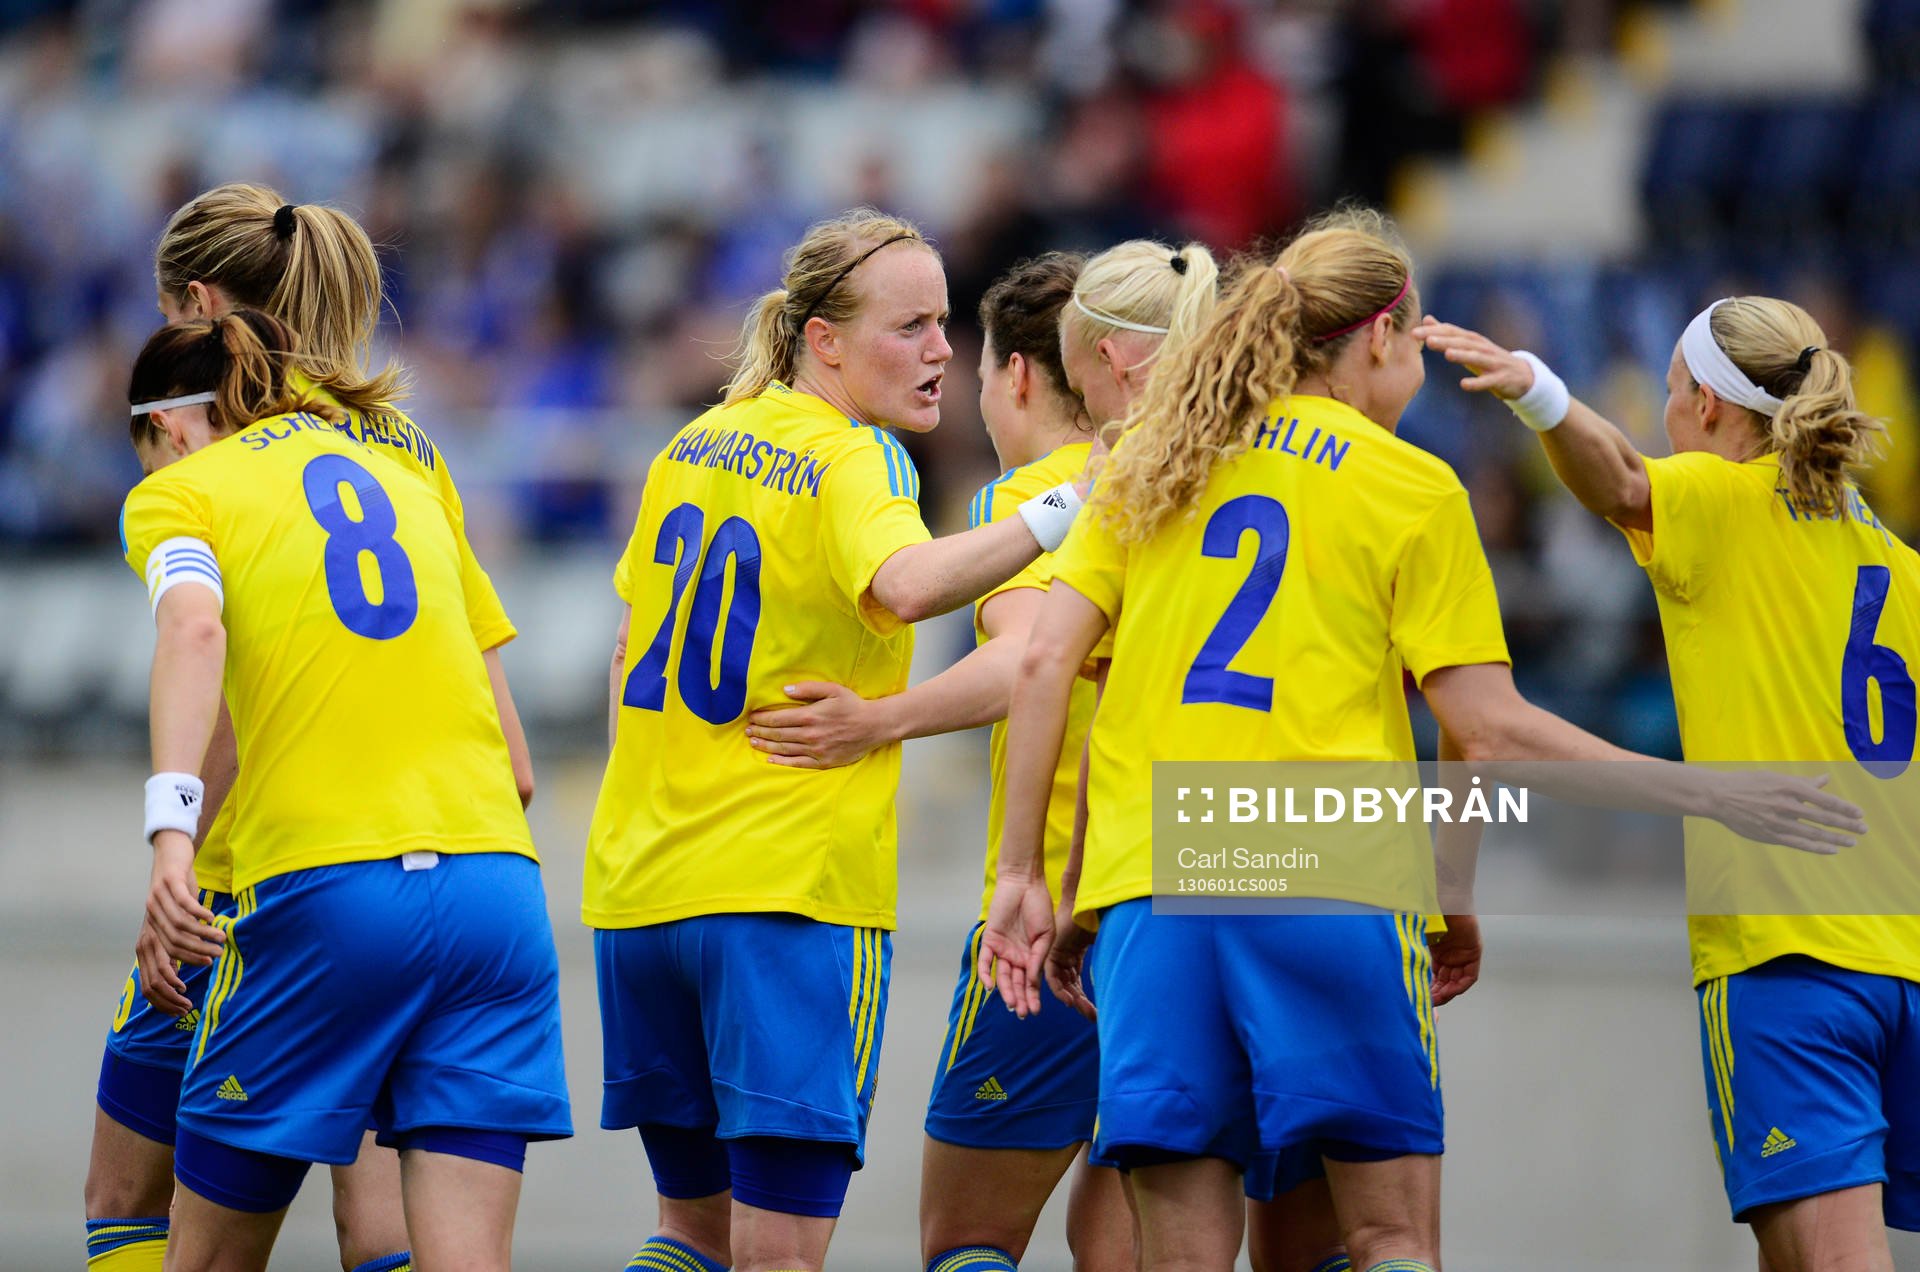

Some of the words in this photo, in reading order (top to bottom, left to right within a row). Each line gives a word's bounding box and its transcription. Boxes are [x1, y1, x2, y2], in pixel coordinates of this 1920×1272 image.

[302, 453, 419, 641] 8
[1253, 415, 1351, 471] HLIN
[622, 502, 762, 725] 20
[1181, 494, 1290, 713] 2
[1841, 565, 1917, 780] 6
